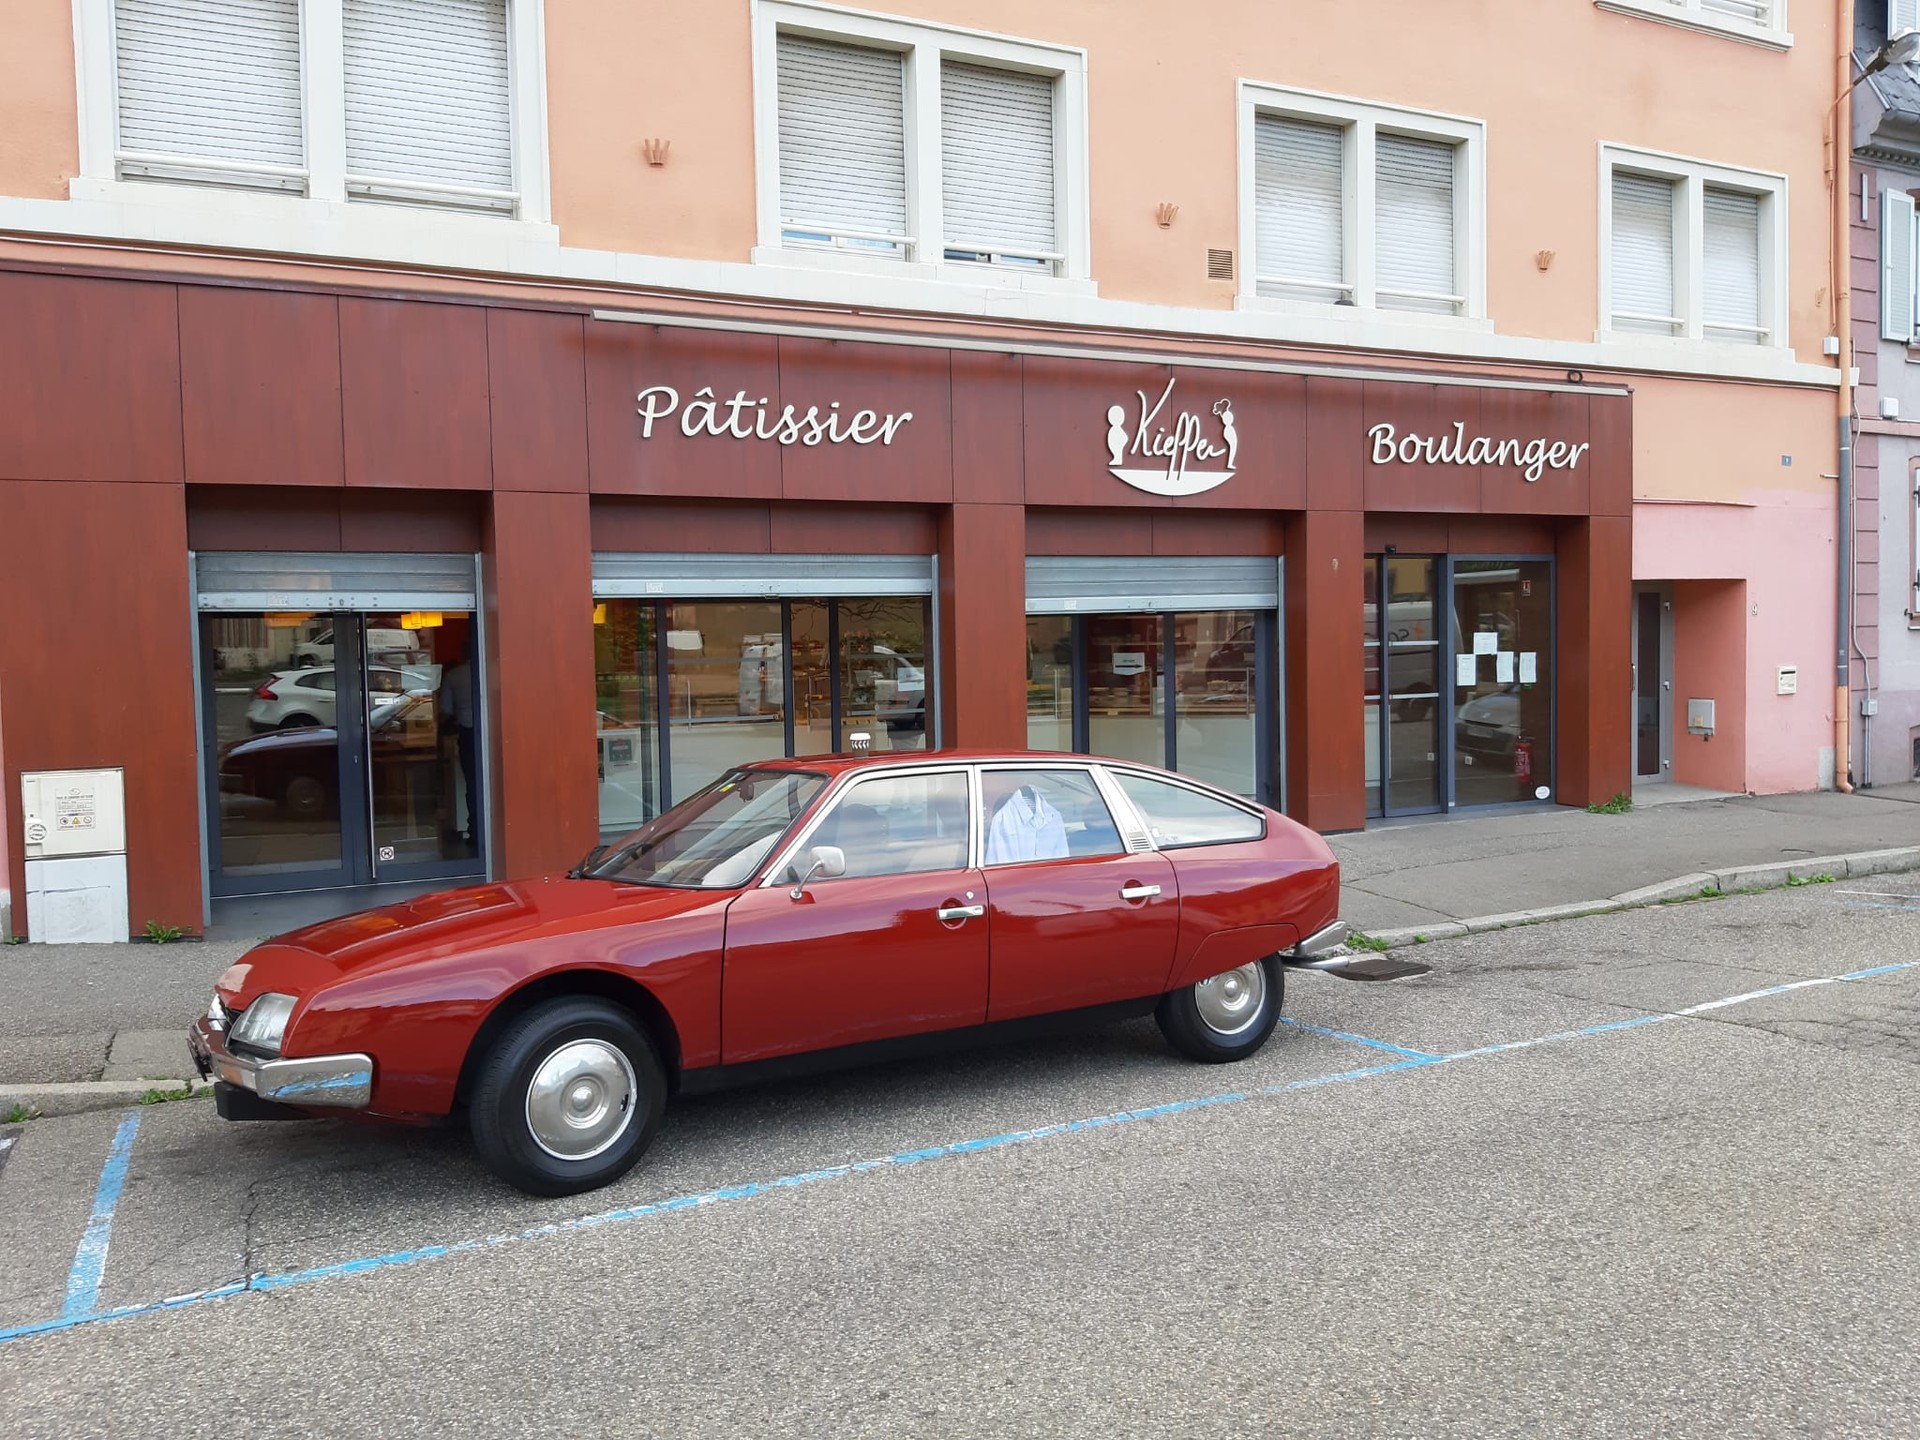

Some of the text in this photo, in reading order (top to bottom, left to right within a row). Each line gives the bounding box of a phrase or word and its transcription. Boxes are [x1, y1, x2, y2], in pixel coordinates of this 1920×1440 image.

[637, 386, 913, 446] Pâtissier
[1130, 377, 1226, 480] Kieffer
[1367, 421, 1588, 482] Boulanger
[1751, 603, 1759, 616] 9
